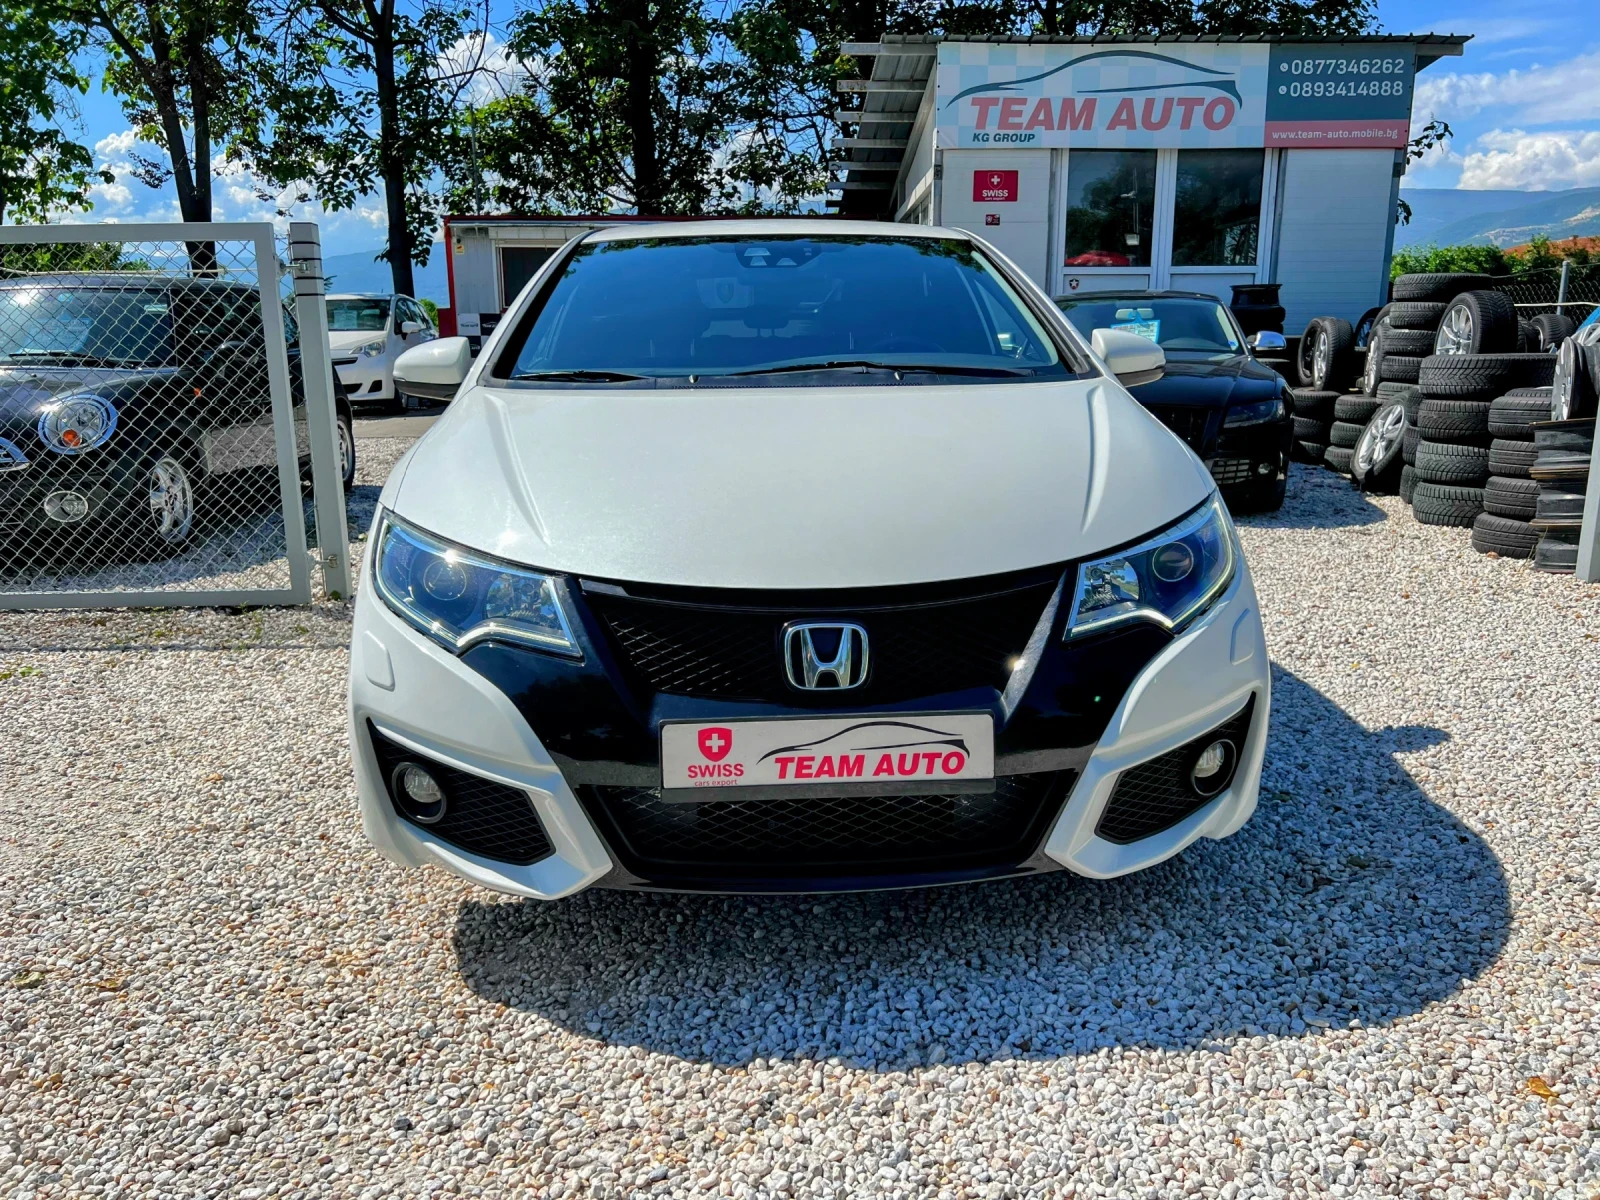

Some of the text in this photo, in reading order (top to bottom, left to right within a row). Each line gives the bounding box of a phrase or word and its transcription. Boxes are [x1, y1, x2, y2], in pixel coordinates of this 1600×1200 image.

[1291, 58, 1405, 75] 0877346262
[1290, 81, 1403, 97] 0893414888
[970, 96, 1235, 131] TEAM AUTO
[972, 133, 1035, 143] KG GROUP
[1272, 128, 1398, 139] www.team-auto.mobile.bg
[982, 189, 1008, 197] SWISS
[687, 763, 744, 779] SWISS
[774, 751, 965, 780] TEAM AUTO
[712, 779, 738, 787] export
